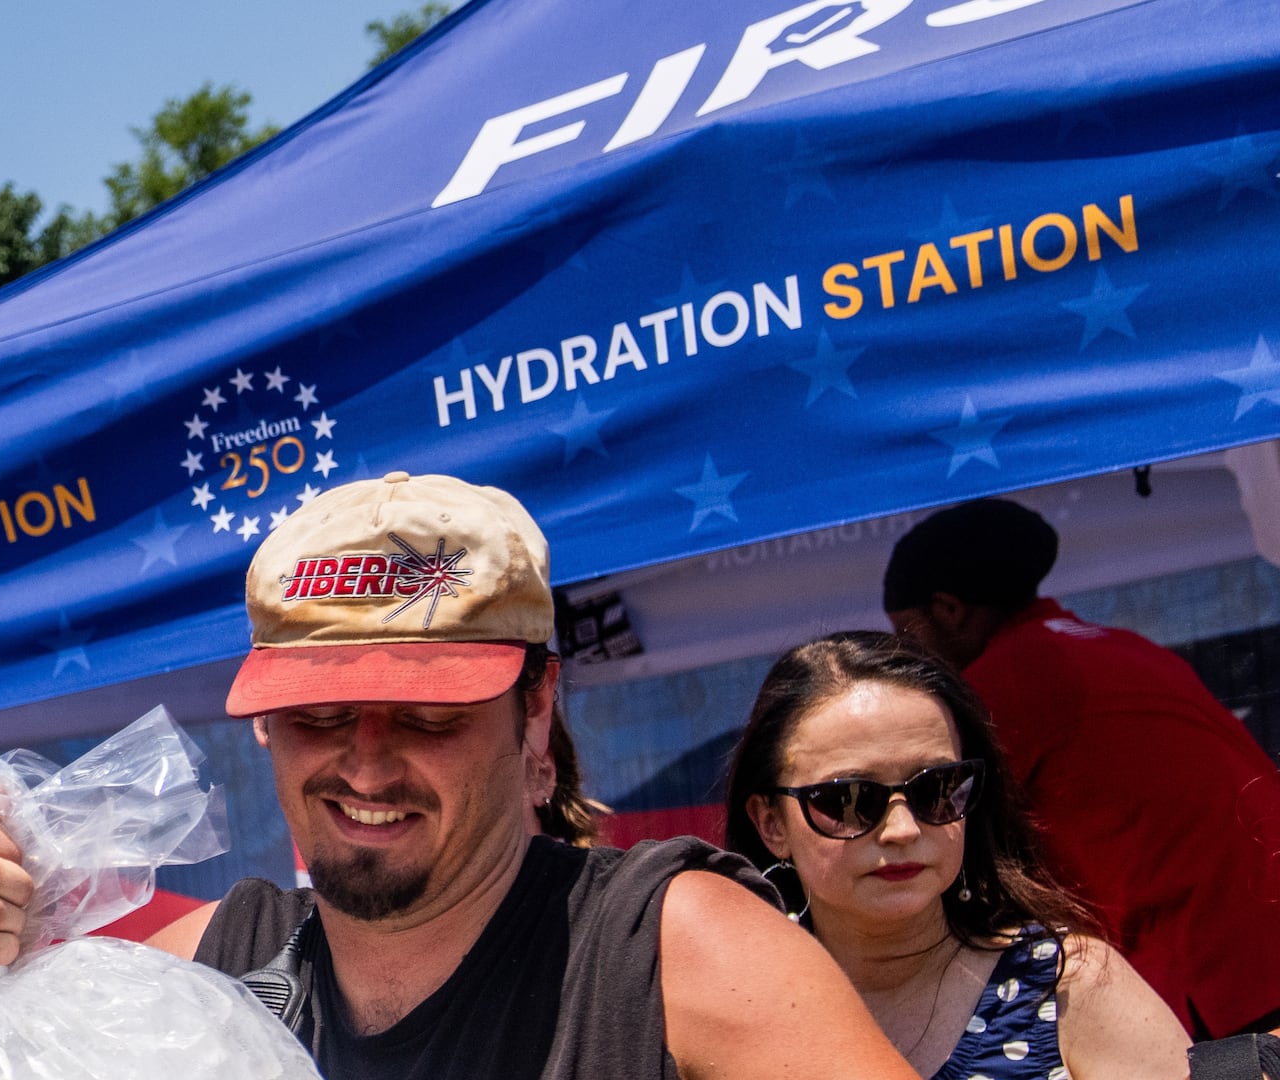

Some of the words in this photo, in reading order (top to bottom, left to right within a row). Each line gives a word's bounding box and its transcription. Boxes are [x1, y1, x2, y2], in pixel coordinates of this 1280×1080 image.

[434, 275, 801, 427] HYDRATION
[821, 194, 1139, 320] STATION
[212, 413, 302, 455] Freedom
[220, 435, 306, 498] 250
